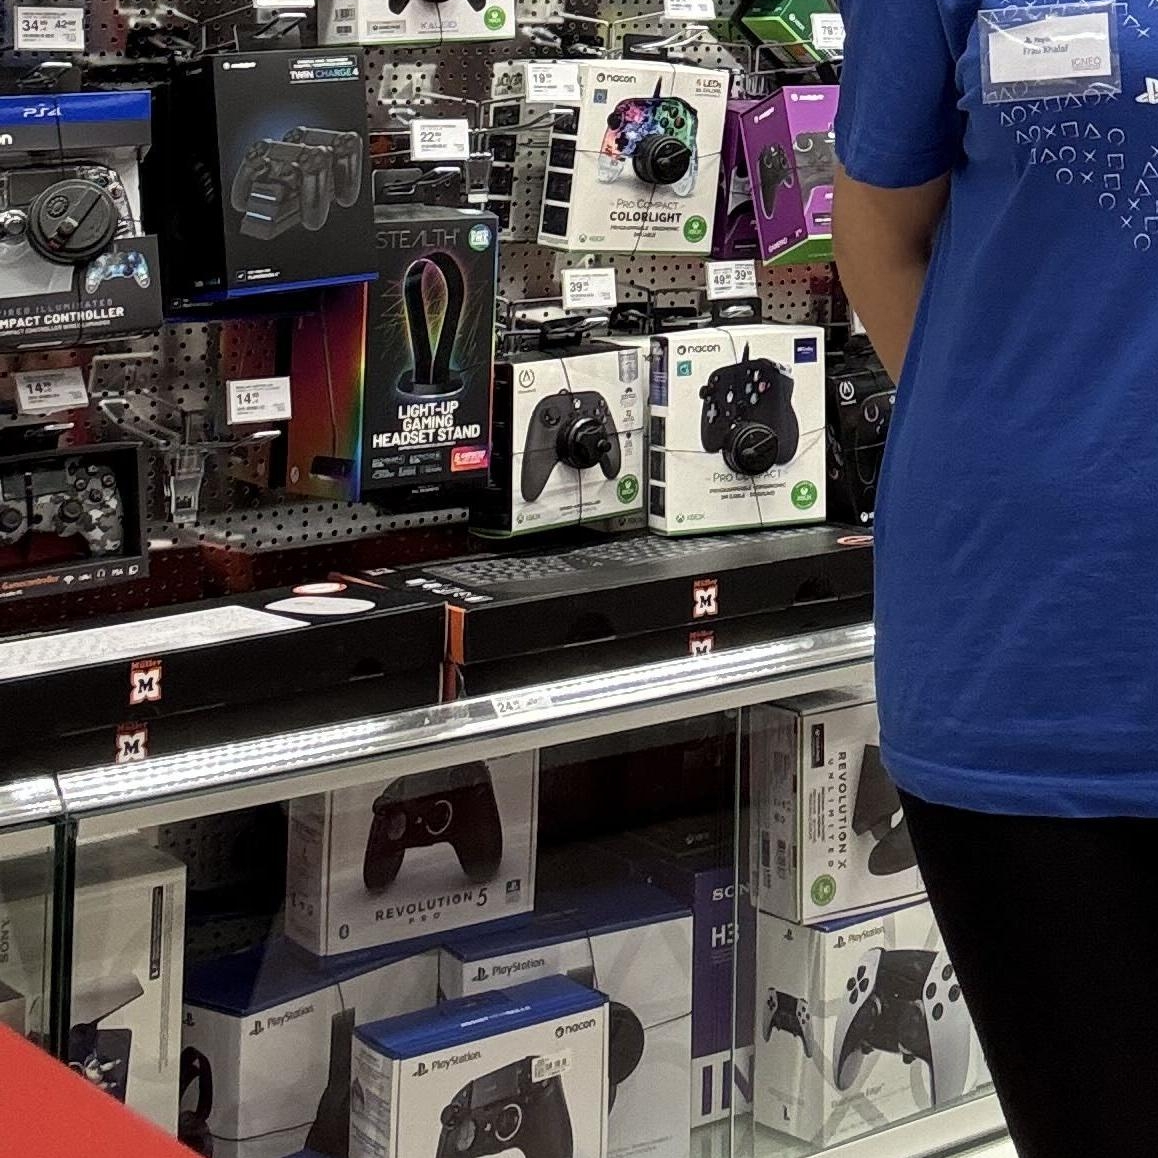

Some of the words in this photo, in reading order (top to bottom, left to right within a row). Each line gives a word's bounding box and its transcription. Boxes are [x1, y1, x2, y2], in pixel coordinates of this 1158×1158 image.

[606, 74, 637, 84] nacon
[23, 106, 63, 119] PS4
[610, 211, 683, 223] COLORLIGHT
[375, 227, 460, 250] STEALTH
[43, 306, 124, 325] CONTROLLER
[687, 344, 721, 354] nacon
[398, 400, 459, 420] LIGHT-UP
[402, 414, 454, 432] GAMING
[372, 429, 434, 449] HEADSET
[437, 423, 481, 442] STAND
[827, 757, 835, 868] UNLIMITED
[837, 751, 847, 856] REVOLUTION
[837, 859, 847, 870] X
[375, 892, 474, 922] REVOLUTION
[477, 887, 488, 907] 5
[409, 911, 441, 925] PRO
[848, 926, 886, 942] PlayStation
[492, 959, 546, 977] PlayStation
[267, 1004, 314, 1029] PlayStation
[565, 1018, 597, 1035] nacon
[431, 1051, 482, 1072] PlayStation
